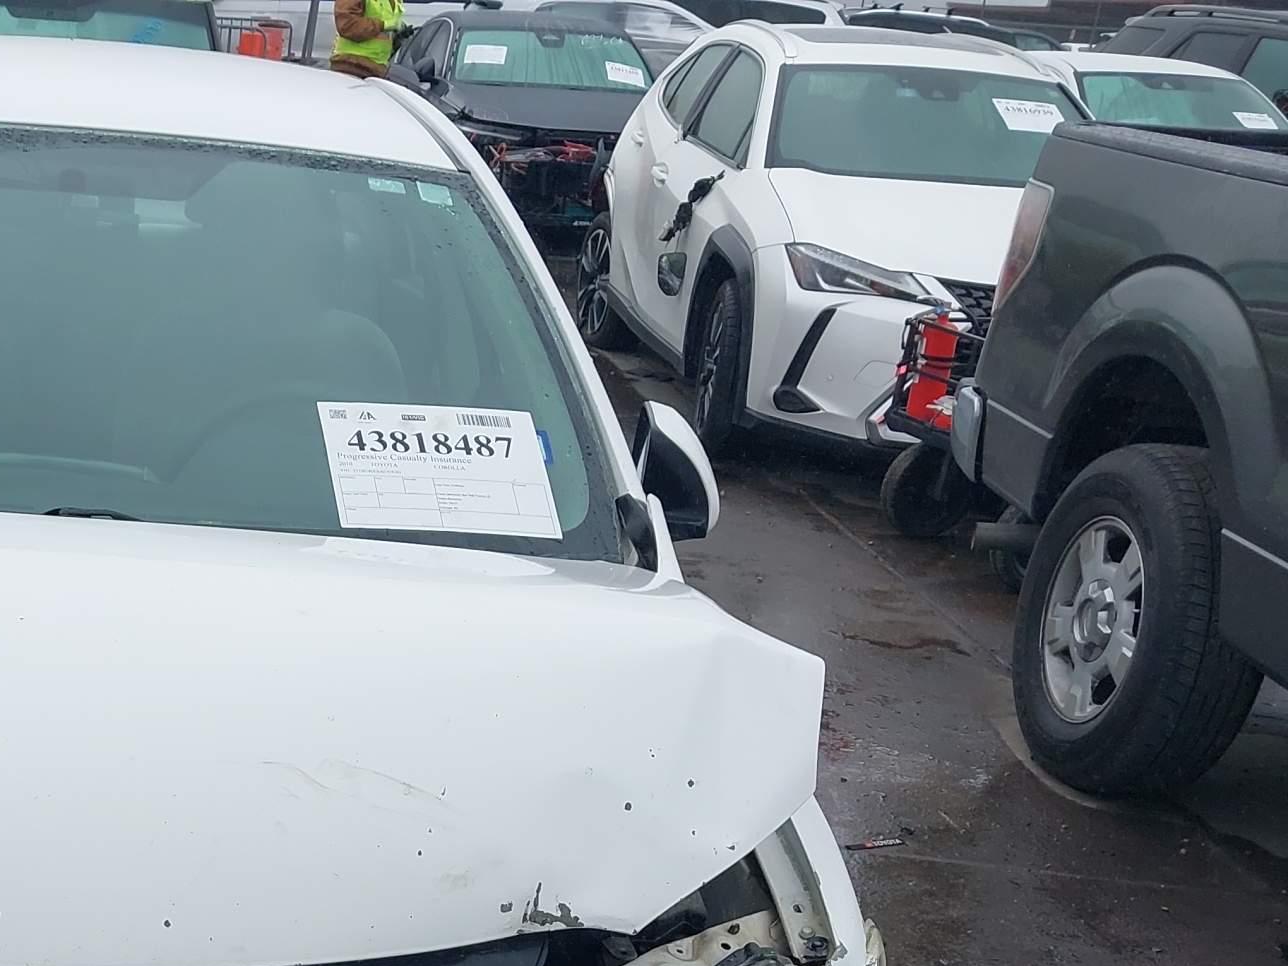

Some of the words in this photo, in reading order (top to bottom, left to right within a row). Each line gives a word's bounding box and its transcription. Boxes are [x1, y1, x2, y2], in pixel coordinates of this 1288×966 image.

[347, 430, 512, 458] 43818487
[337, 452, 388, 462] Progressive
[390, 454, 427, 463] Casualty
[431, 455, 472, 464] Insurance
